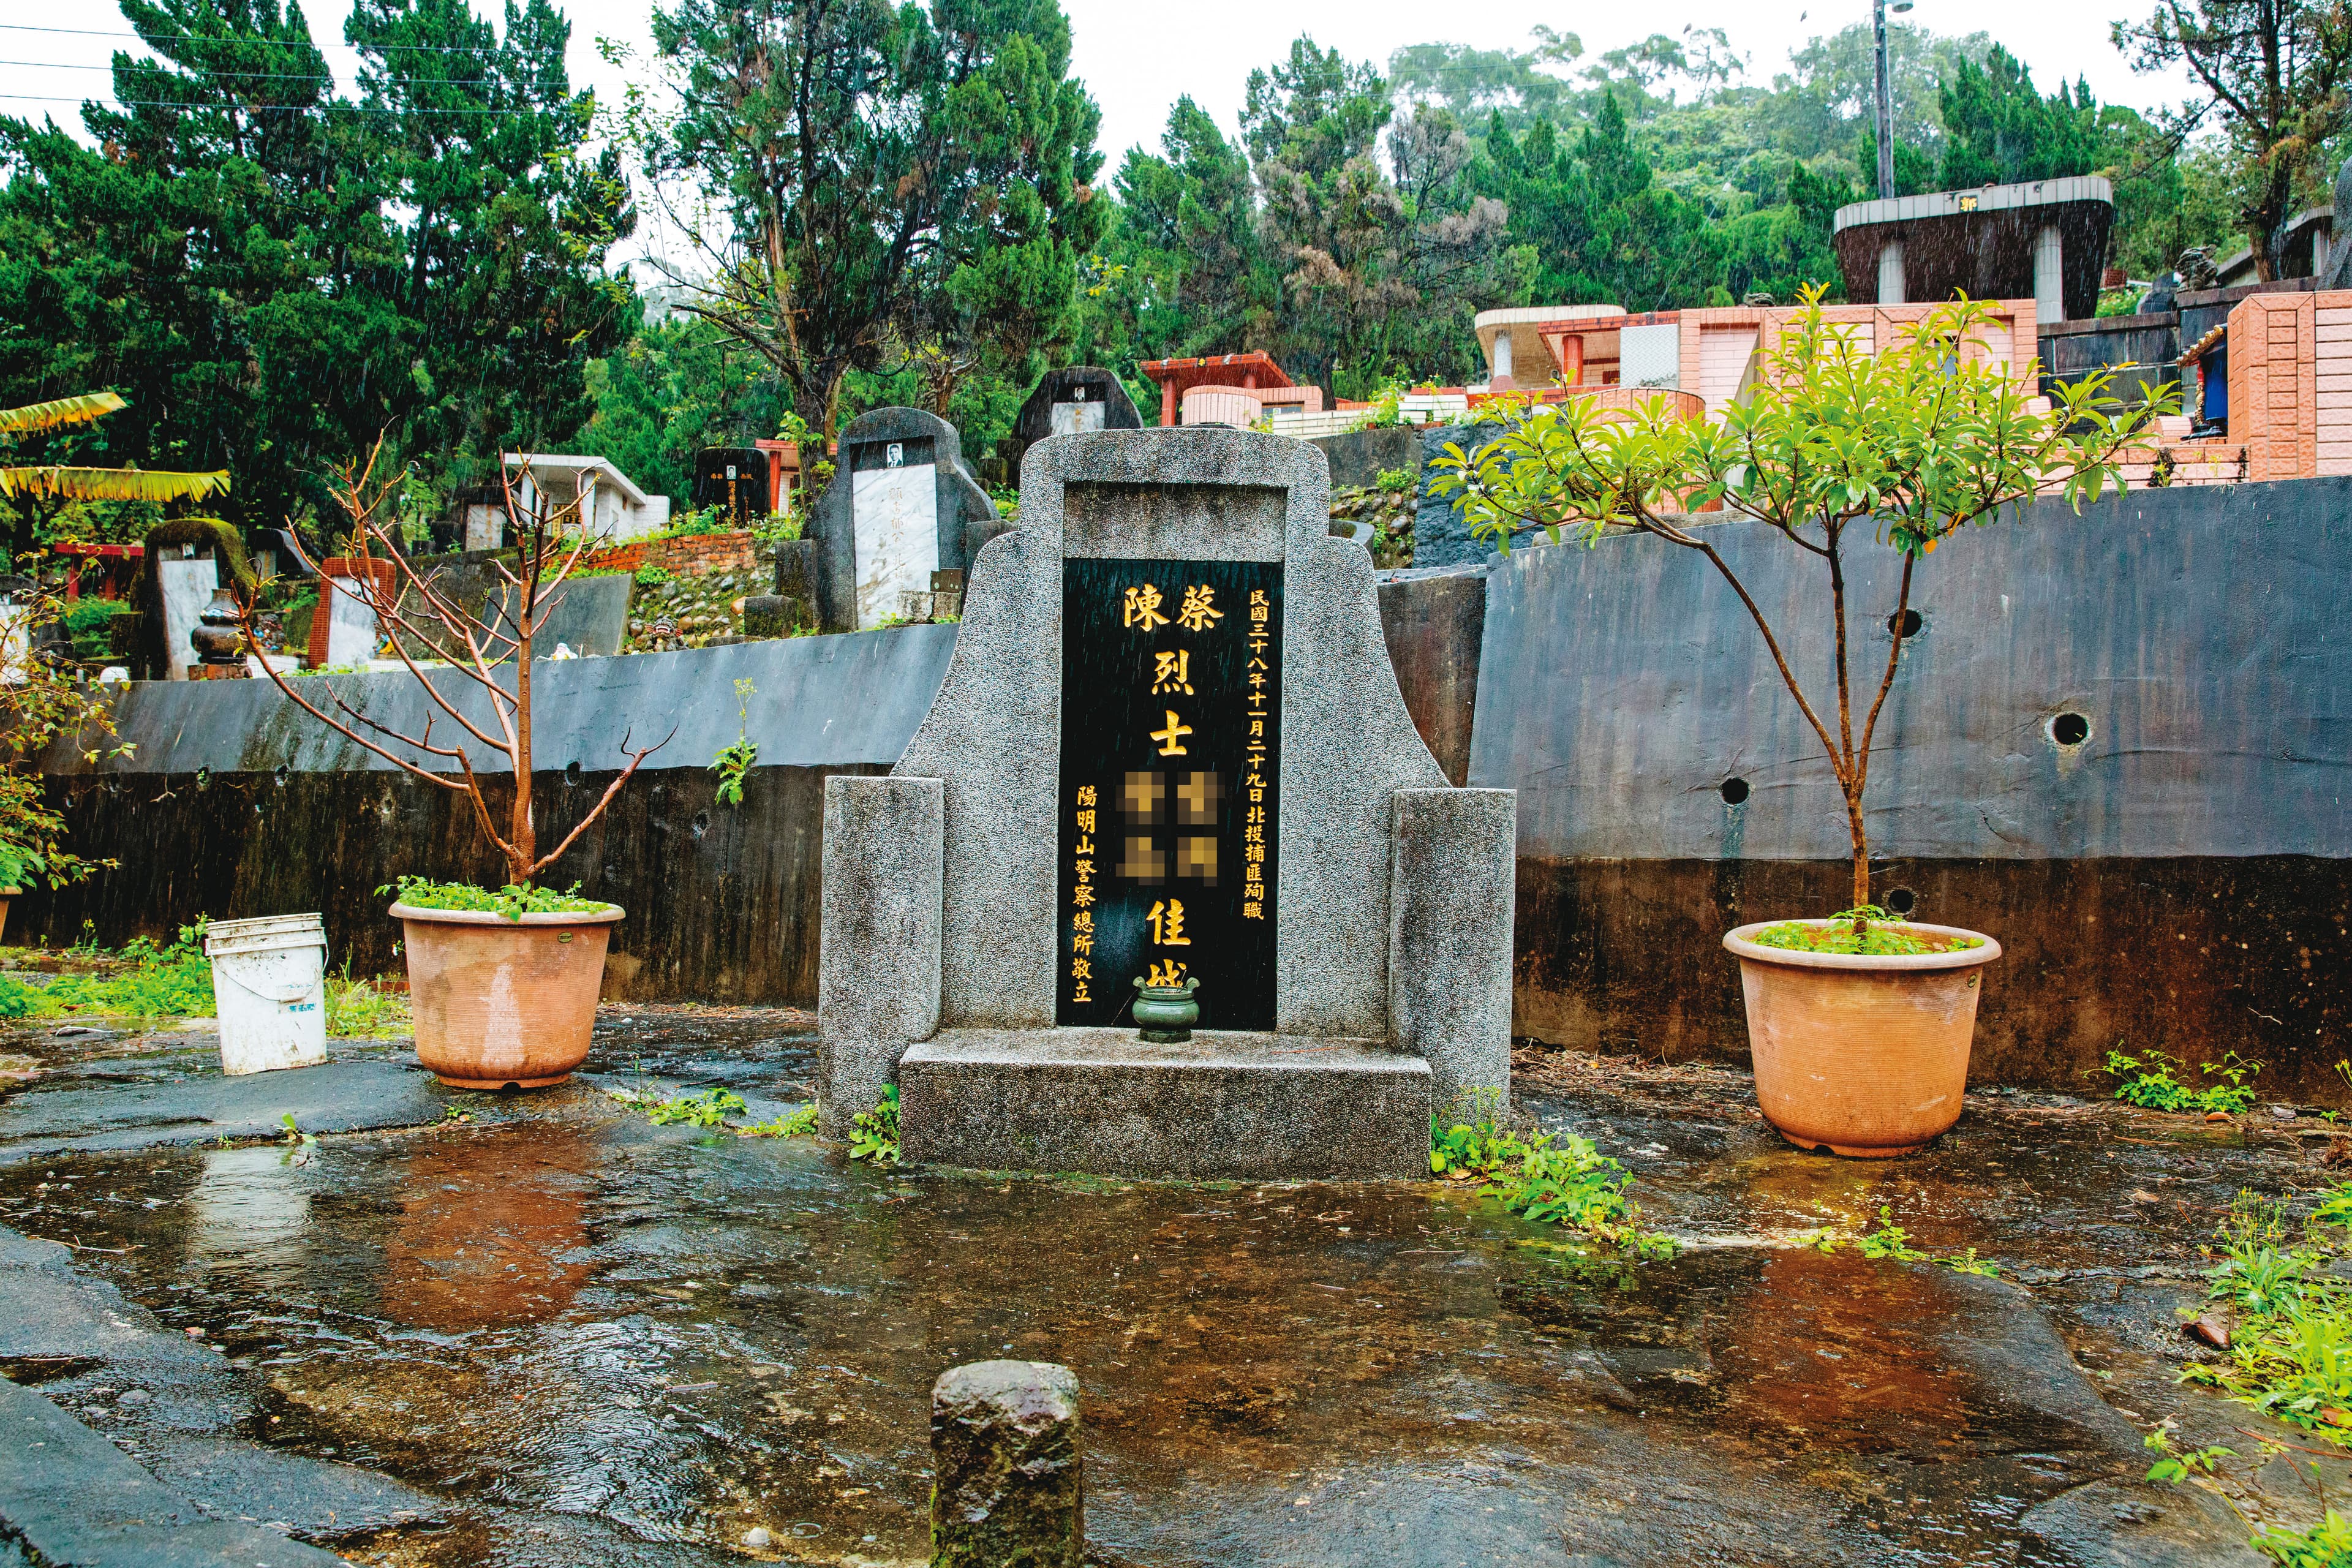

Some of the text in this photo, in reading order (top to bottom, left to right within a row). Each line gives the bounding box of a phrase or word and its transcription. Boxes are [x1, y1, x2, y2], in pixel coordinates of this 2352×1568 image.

[1150, 649, 1194, 756] 烈士
[1242, 589, 1270, 920] 民國三十八年十一月二十九日北投捕匪殉職
[1071, 785, 1098, 1003] 陽明山警察總所敬立
